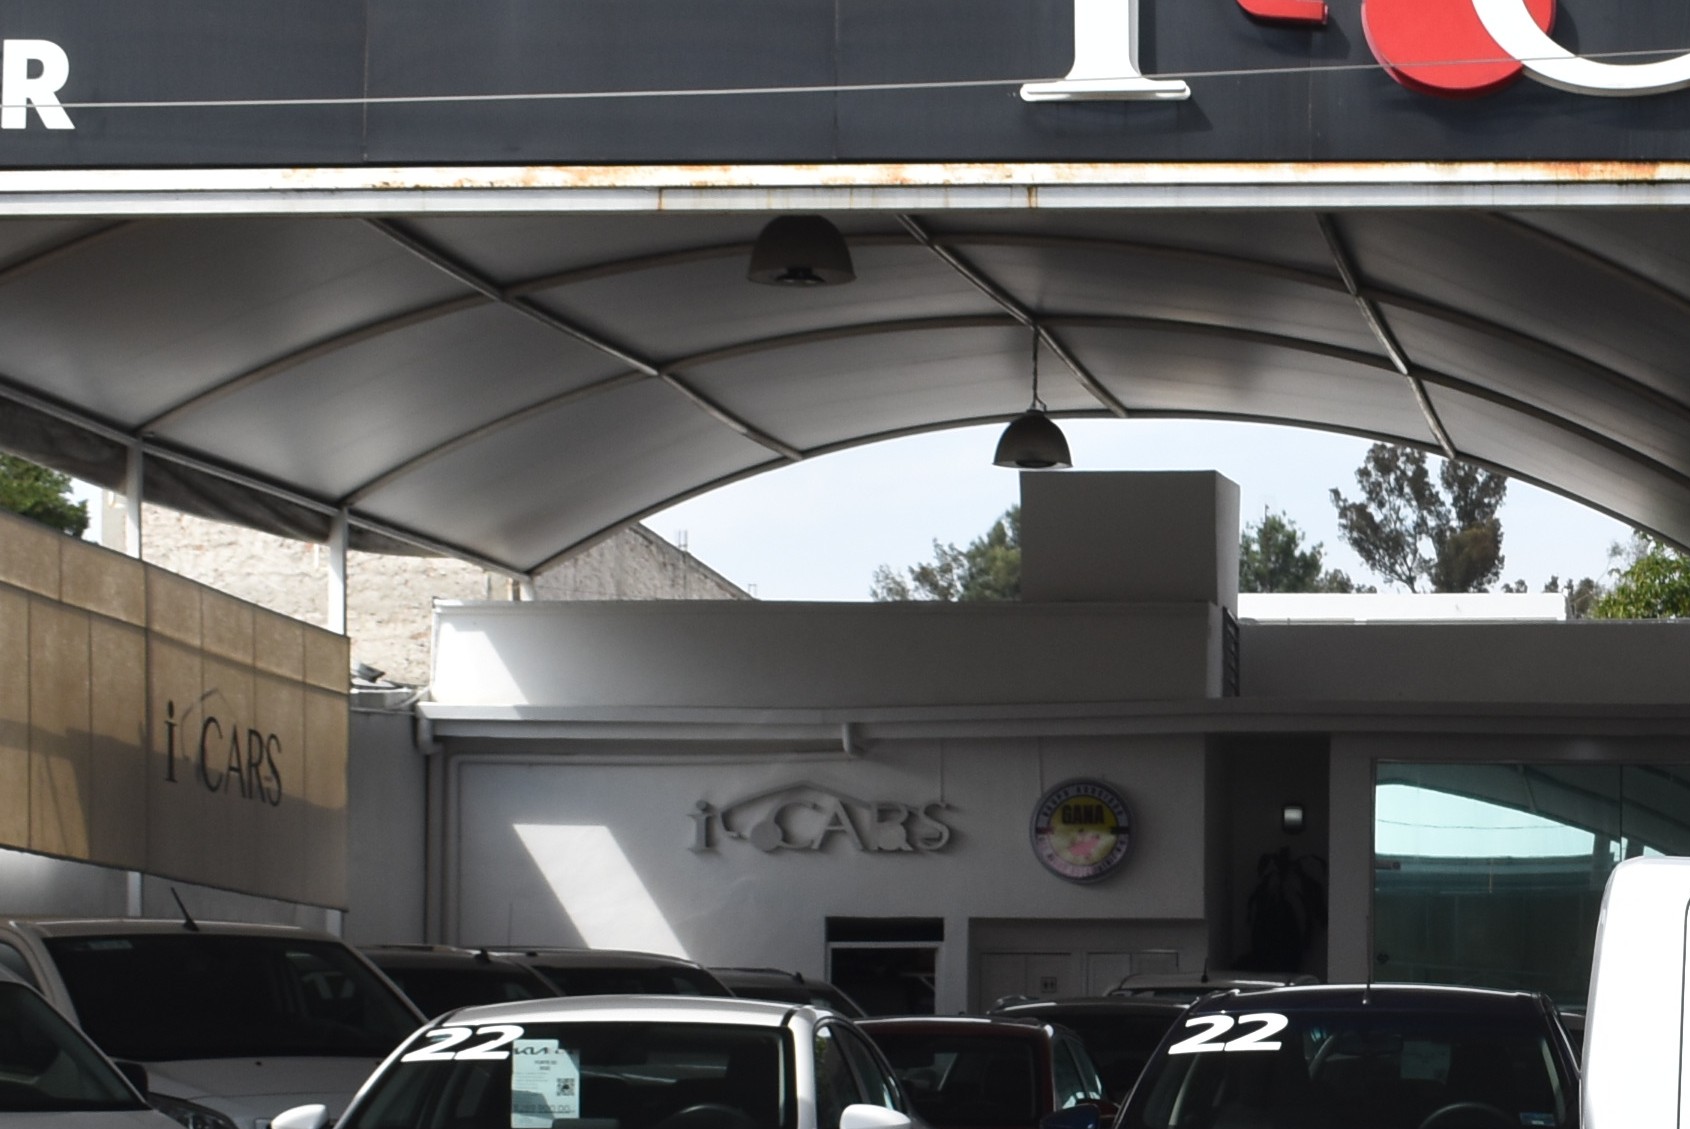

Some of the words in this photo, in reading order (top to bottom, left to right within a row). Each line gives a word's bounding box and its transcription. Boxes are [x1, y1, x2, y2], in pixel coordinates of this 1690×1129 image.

[201, 716, 282, 807] CARS
[772, 797, 950, 852] CARS
[1062, 804, 1105, 825] GANA
[401, 1024, 525, 1062] 22
[1169, 1013, 1288, 1055] 22
